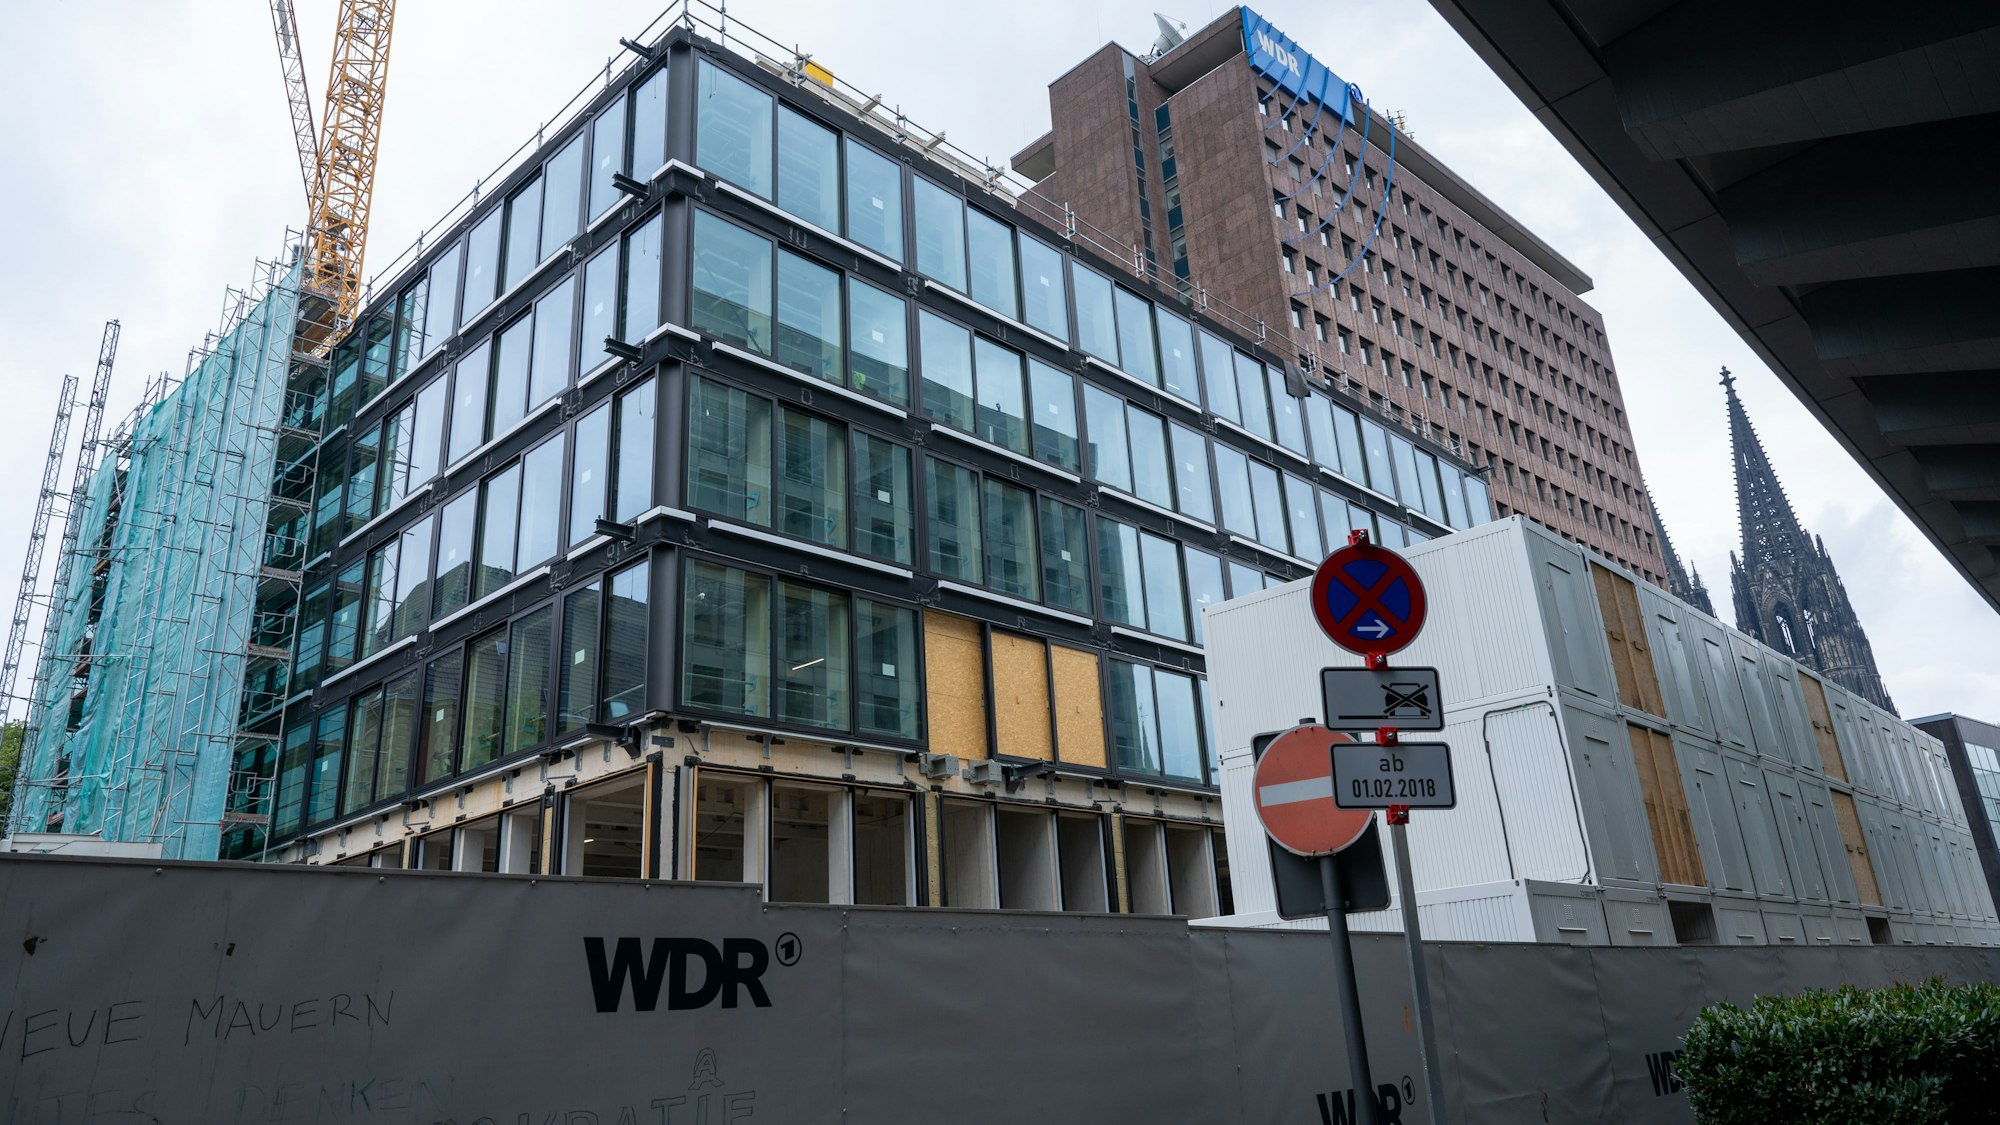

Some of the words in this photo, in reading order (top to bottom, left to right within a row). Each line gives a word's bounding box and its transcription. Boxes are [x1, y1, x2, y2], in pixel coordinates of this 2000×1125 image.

[1257, 29, 1300, 77] WDR
[1379, 753, 1404, 772] ab
[1352, 778, 1436, 798] 01.02.2018
[583, 937, 773, 1013] WDR
[185, 991, 394, 1046] MAUERN
[1645, 1049, 1686, 1097] WD
[1316, 1083, 1403, 1125] WR
